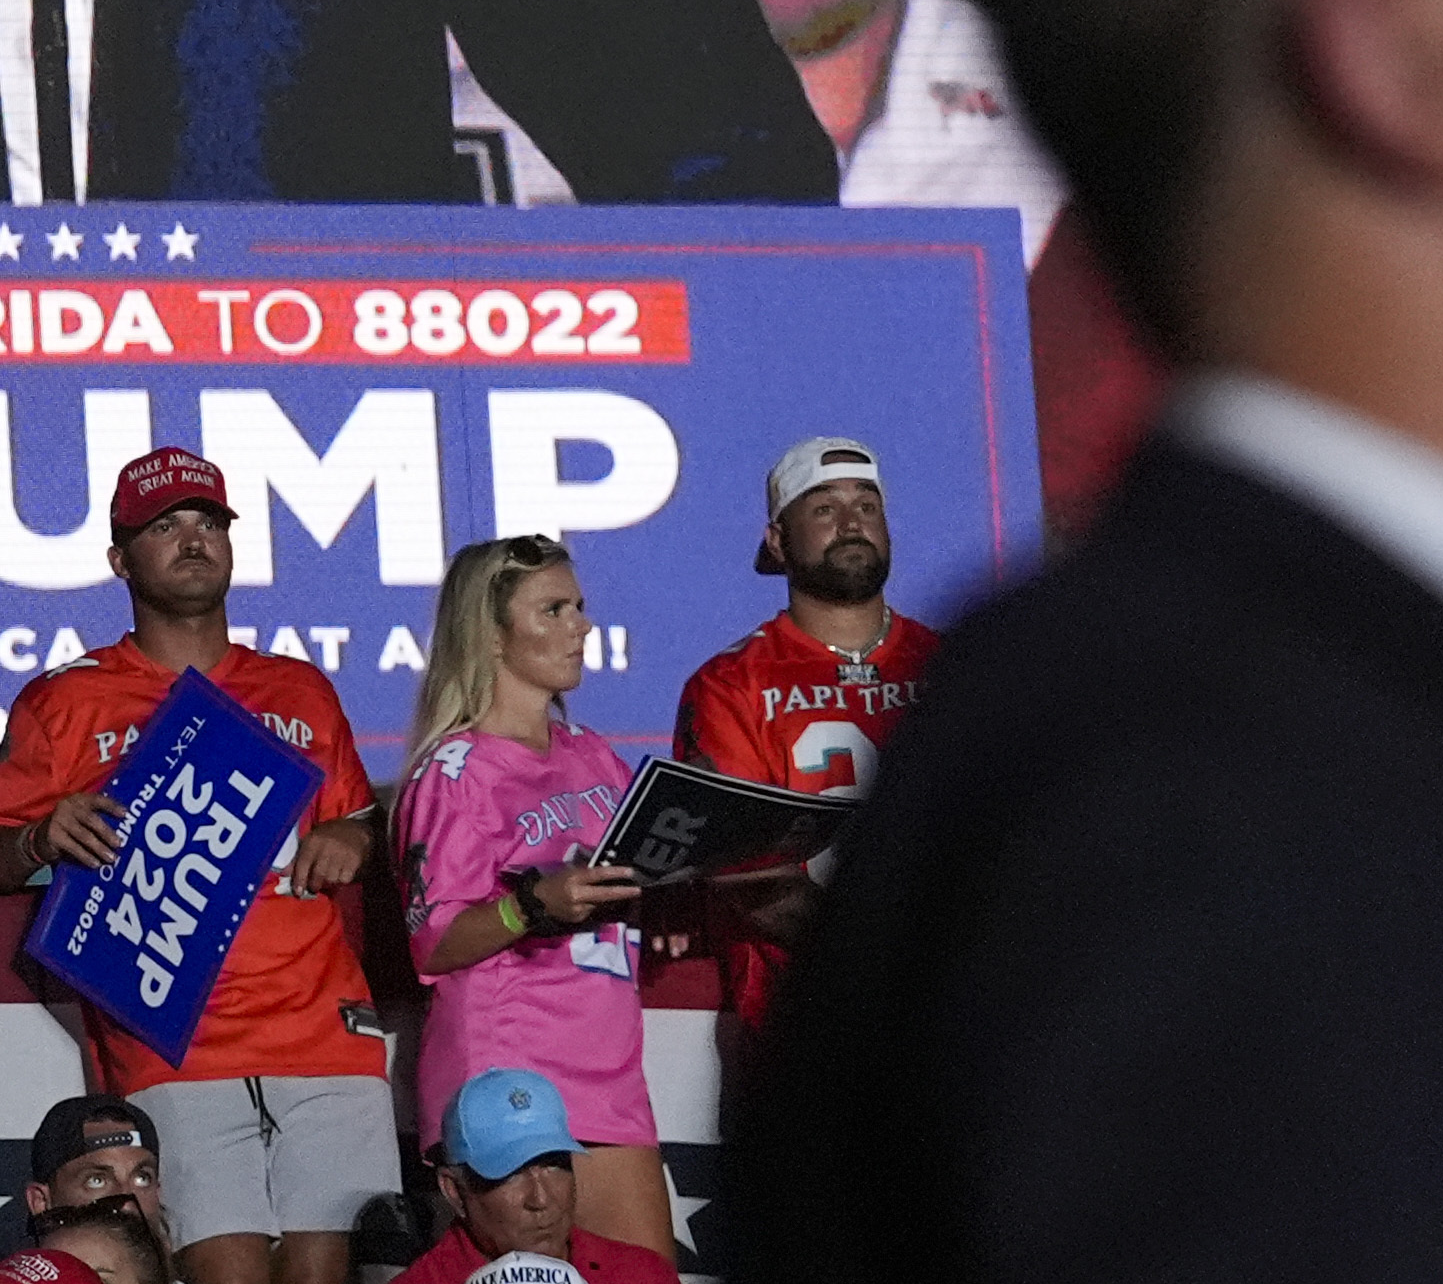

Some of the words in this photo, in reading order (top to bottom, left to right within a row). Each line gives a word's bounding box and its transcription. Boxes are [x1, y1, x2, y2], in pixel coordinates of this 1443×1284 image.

[198, 288, 323, 355] TO
[353, 288, 642, 355] 88022
[127, 457, 163, 482] MAKE
[138, 470, 175, 497] GREAT
[181, 470, 216, 489] AGAIN
[762, 684, 849, 722] PAPI
[164, 716, 206, 771] TEXT
[119, 772, 166, 849] TRUMP
[104, 762, 214, 947] 2024
[67, 884, 105, 957] 88022
[135, 768, 276, 1009] TRUMP
